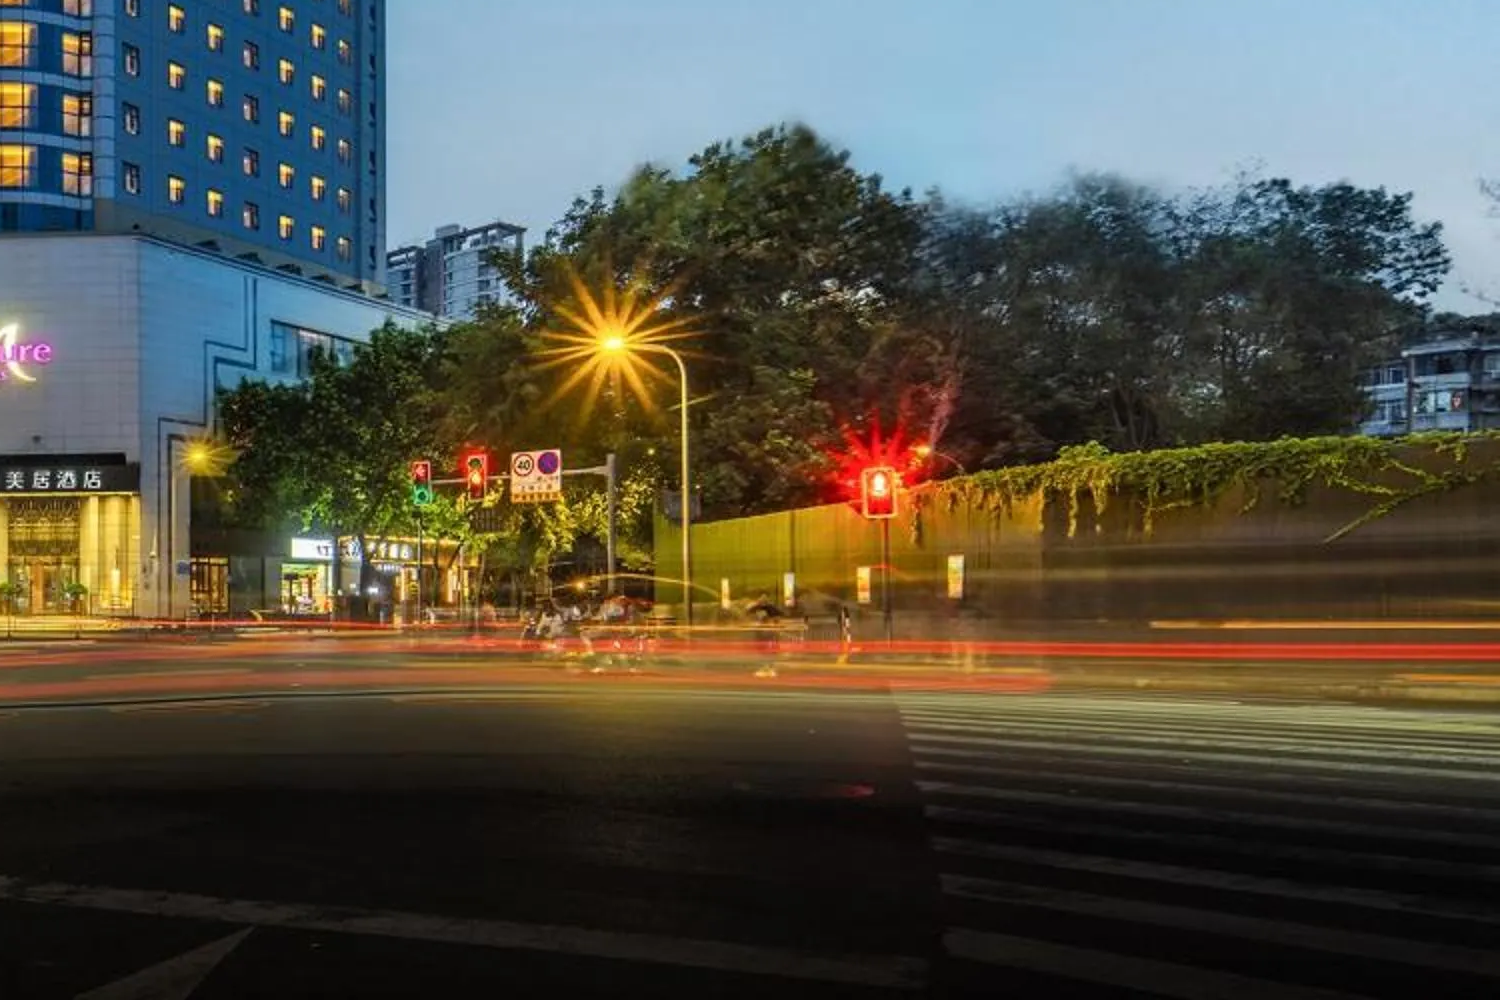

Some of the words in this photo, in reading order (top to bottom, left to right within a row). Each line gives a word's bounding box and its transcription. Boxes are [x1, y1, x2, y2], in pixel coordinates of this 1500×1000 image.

[518, 460, 530, 470] 40
[5, 470, 102, 490] 美居酒店
